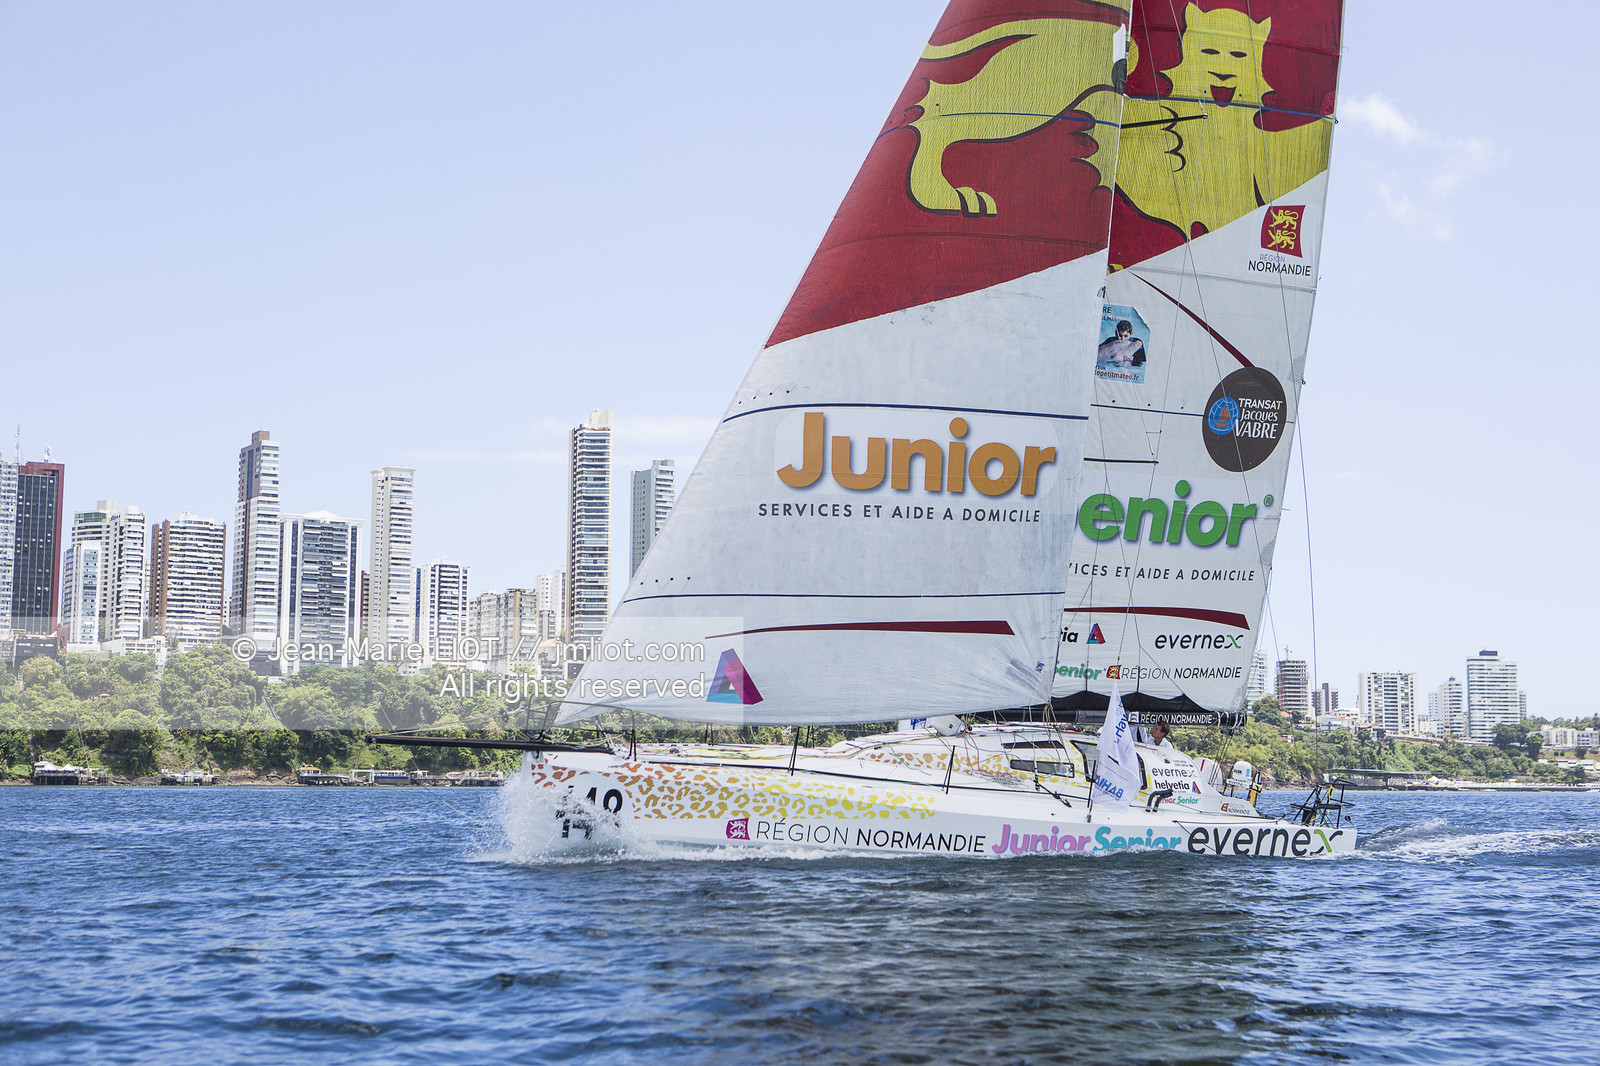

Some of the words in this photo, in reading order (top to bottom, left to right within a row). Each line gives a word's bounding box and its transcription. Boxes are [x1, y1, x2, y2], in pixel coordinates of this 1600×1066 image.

[1259, 253, 1286, 263] RÉGION
[1248, 260, 1312, 277] NORMANDIE
[1238, 397, 1283, 410] TRANSAT
[1240, 408, 1279, 425] Jacques
[1235, 419, 1278, 439] VABRE
[776, 412, 1056, 496] Junior
[758, 503, 852, 517] SERVICES
[863, 504, 882, 519] ET
[892, 506, 935, 520] AIDE
[942, 507, 954, 521] A
[962, 508, 1041, 523] DOMICILE
[1069, 562, 1108, 577] ICES
[1115, 566, 1131, 578] ET
[1136, 568, 1170, 580] AIDE
[1175, 569, 1184, 580] A
[1190, 569, 1256, 581] DOMICILE
[1154, 634, 1244, 650] evernex
[1121, 665, 1171, 680] RÉGION
[1173, 666, 1242, 680] NORMANDIE
[1141, 711, 1169, 724] RÉGION
[1170, 714, 1213, 724] NORMANDIE
[1151, 767, 1198, 778] evernex
[1154, 780, 1190, 790] helvetia
[755, 818, 849, 845] RÉGION
[856, 828, 986, 853] NORMANDIE
[991, 824, 1091, 854] Junior
[1092, 826, 1182, 852] Senior
[1188, 827, 1344, 856] evernex
